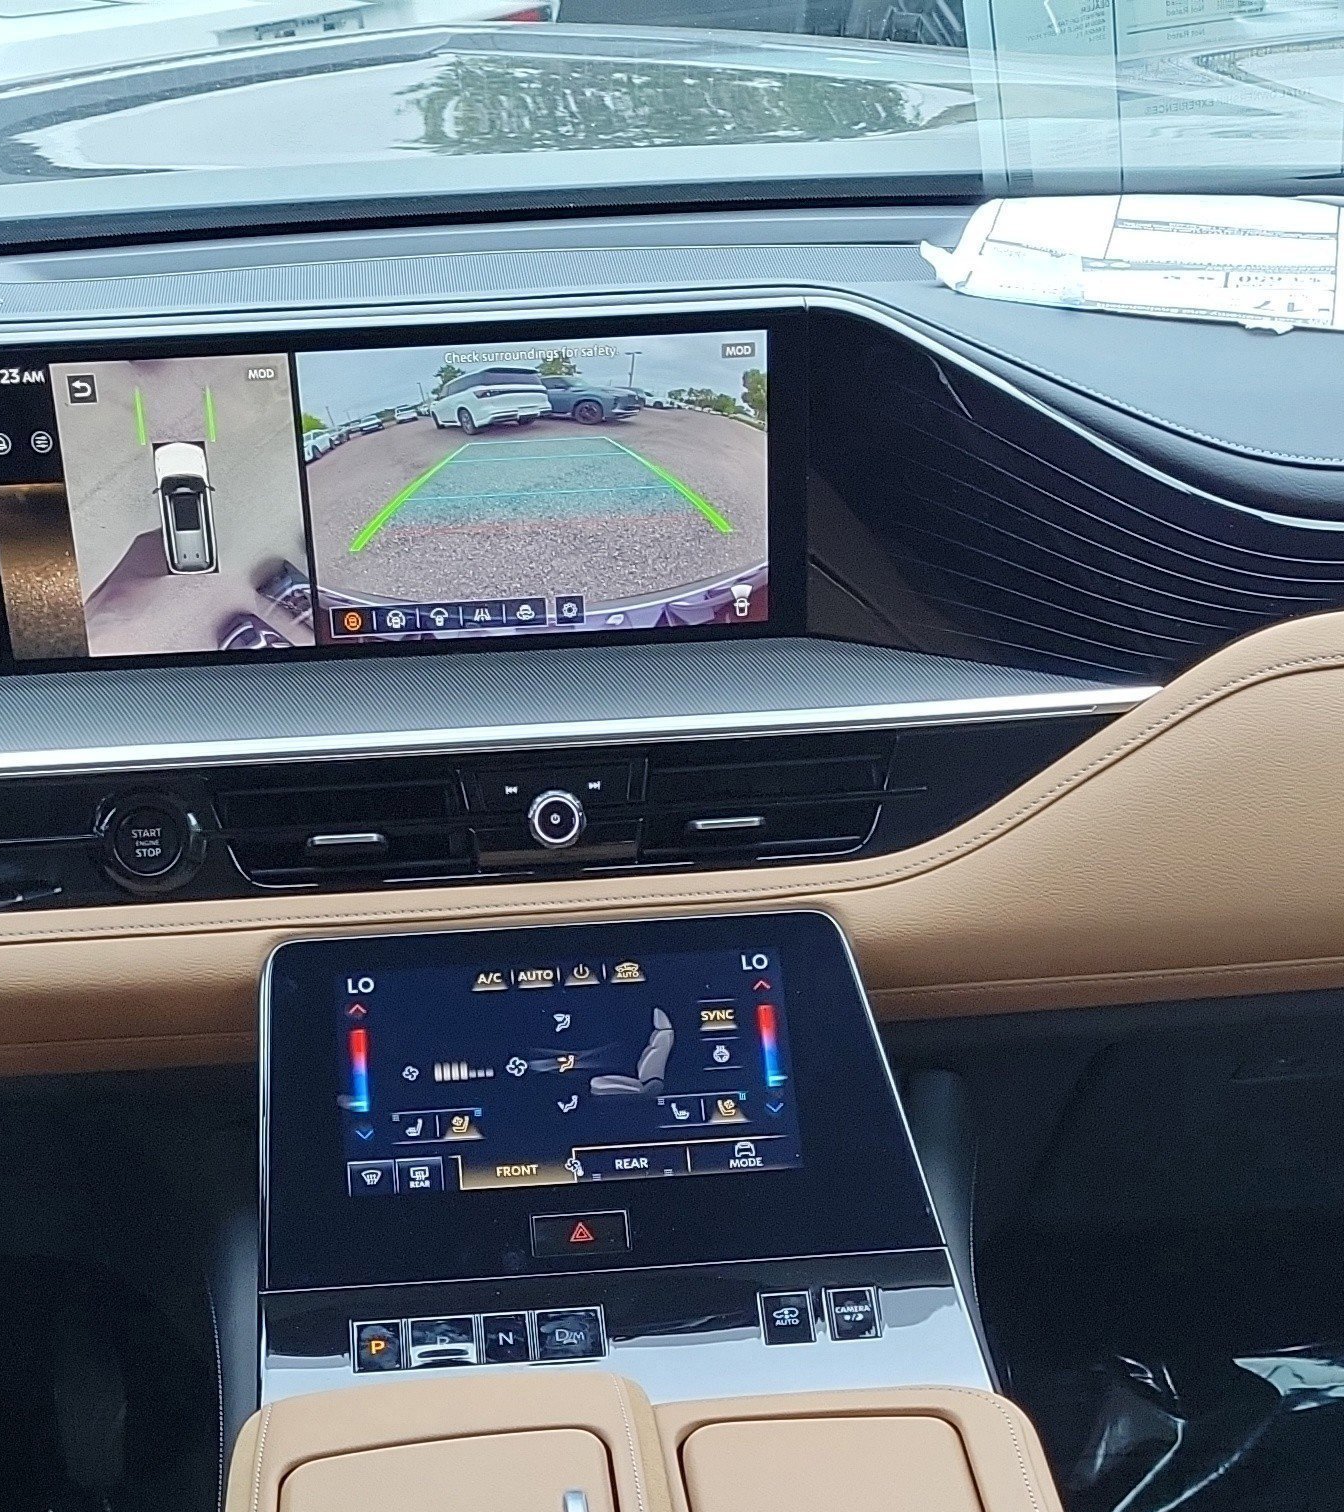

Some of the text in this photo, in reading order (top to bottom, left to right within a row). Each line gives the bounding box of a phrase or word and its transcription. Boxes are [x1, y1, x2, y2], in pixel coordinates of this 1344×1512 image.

[444, 350, 479, 364] Check
[482, 347, 561, 365] surroundings
[562, 345, 580, 359] for
[725, 344, 752, 356] MOD
[22, 370, 45, 384] AM
[248, 368, 274, 380] MOD
[132, 828, 162, 838] START
[136, 848, 162, 858] STOP
[741, 954, 768, 971] LO
[478, 968, 554, 986] A/C AUTO
[616, 970, 640, 980] AUTO
[346, 976, 375, 995] LO
[700, 1008, 735, 1023] SYNC
[614, 1156, 649, 1170] REAR
[729, 1157, 764, 1168] MODE
[496, 1163, 538, 1178] FRONT
[410, 1178, 430, 1189] REAR
[835, 1305, 870, 1314] CAMERA
[775, 1318, 800, 1326] AUTO
[370, 1339, 385, 1355] P
[498, 1331, 514, 1346] N
